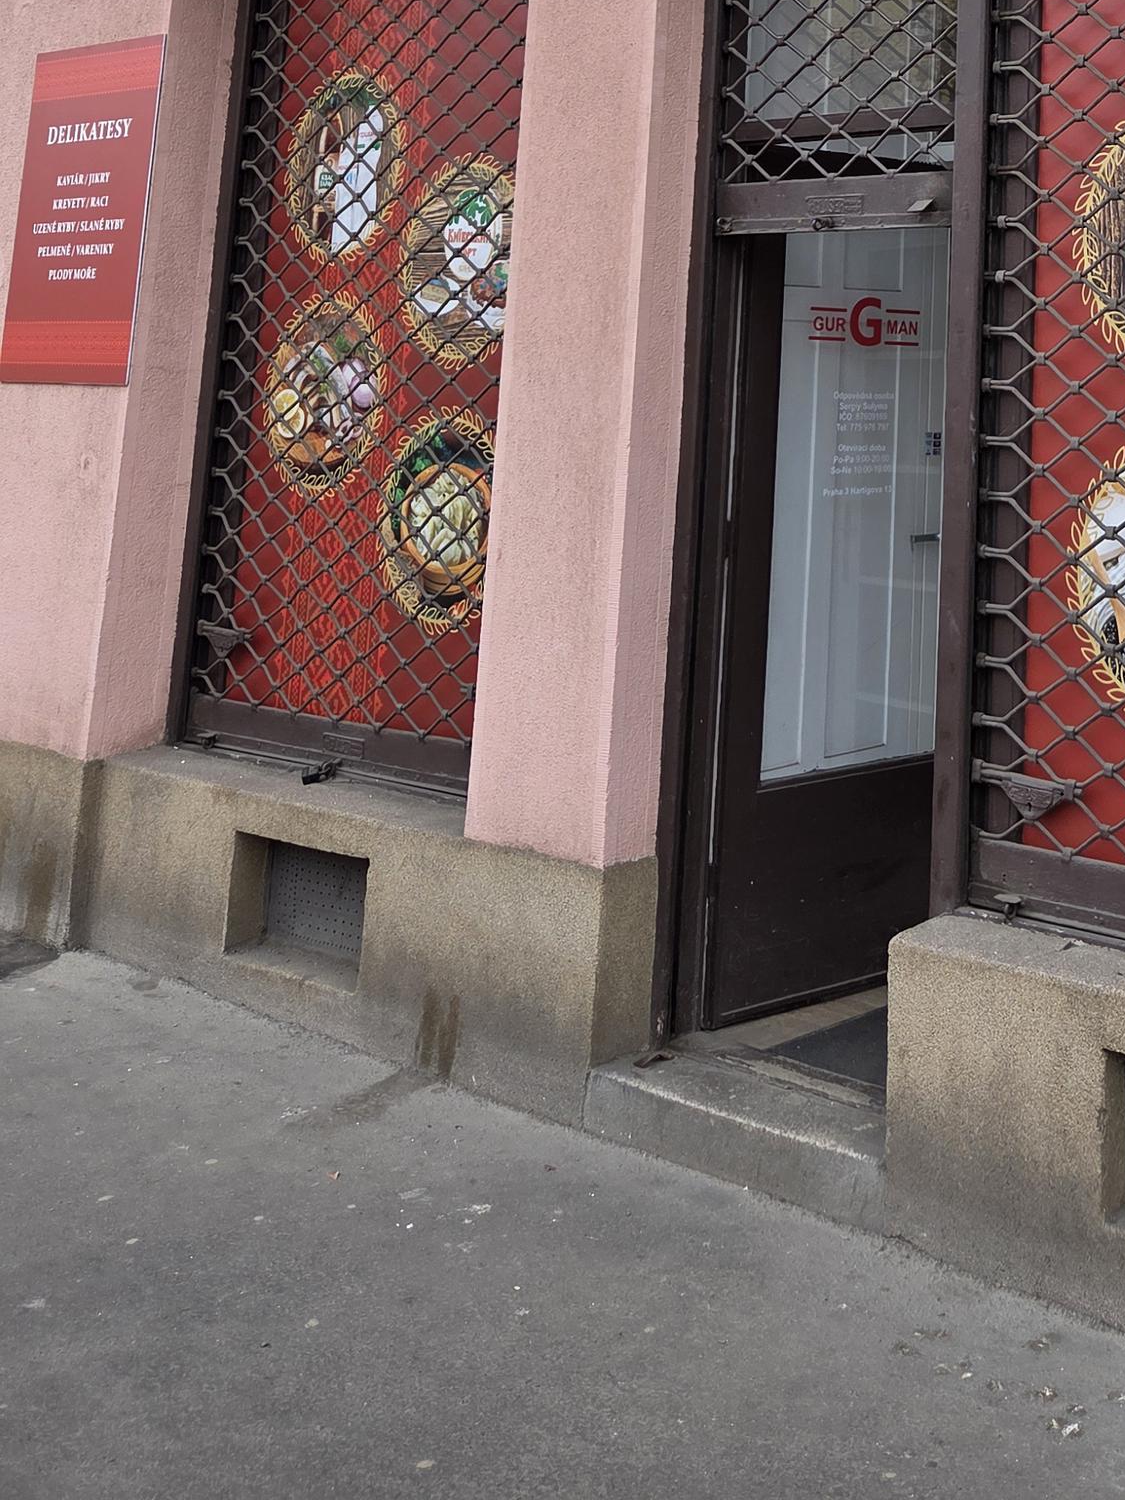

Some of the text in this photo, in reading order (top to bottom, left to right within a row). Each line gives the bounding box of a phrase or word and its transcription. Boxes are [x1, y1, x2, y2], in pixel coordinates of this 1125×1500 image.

[47, 118, 133, 145] DELIKATESY
[57, 173, 84, 186] KAVIÁR
[88, 172, 110, 187] JIKRY
[53, 197, 86, 210] KREVETY
[90, 196, 108, 207] RACI
[33, 220, 57, 234] UZENÉ
[57, 222, 76, 233] RYBY
[80, 217, 104, 232] SLANÉ
[104, 219, 125, 230] RYBY
[76, 243, 114, 255] VARENIKY
[48, 266, 97, 280] PLODY MOŘE
[813, 297, 919, 347] GUR G MAN
